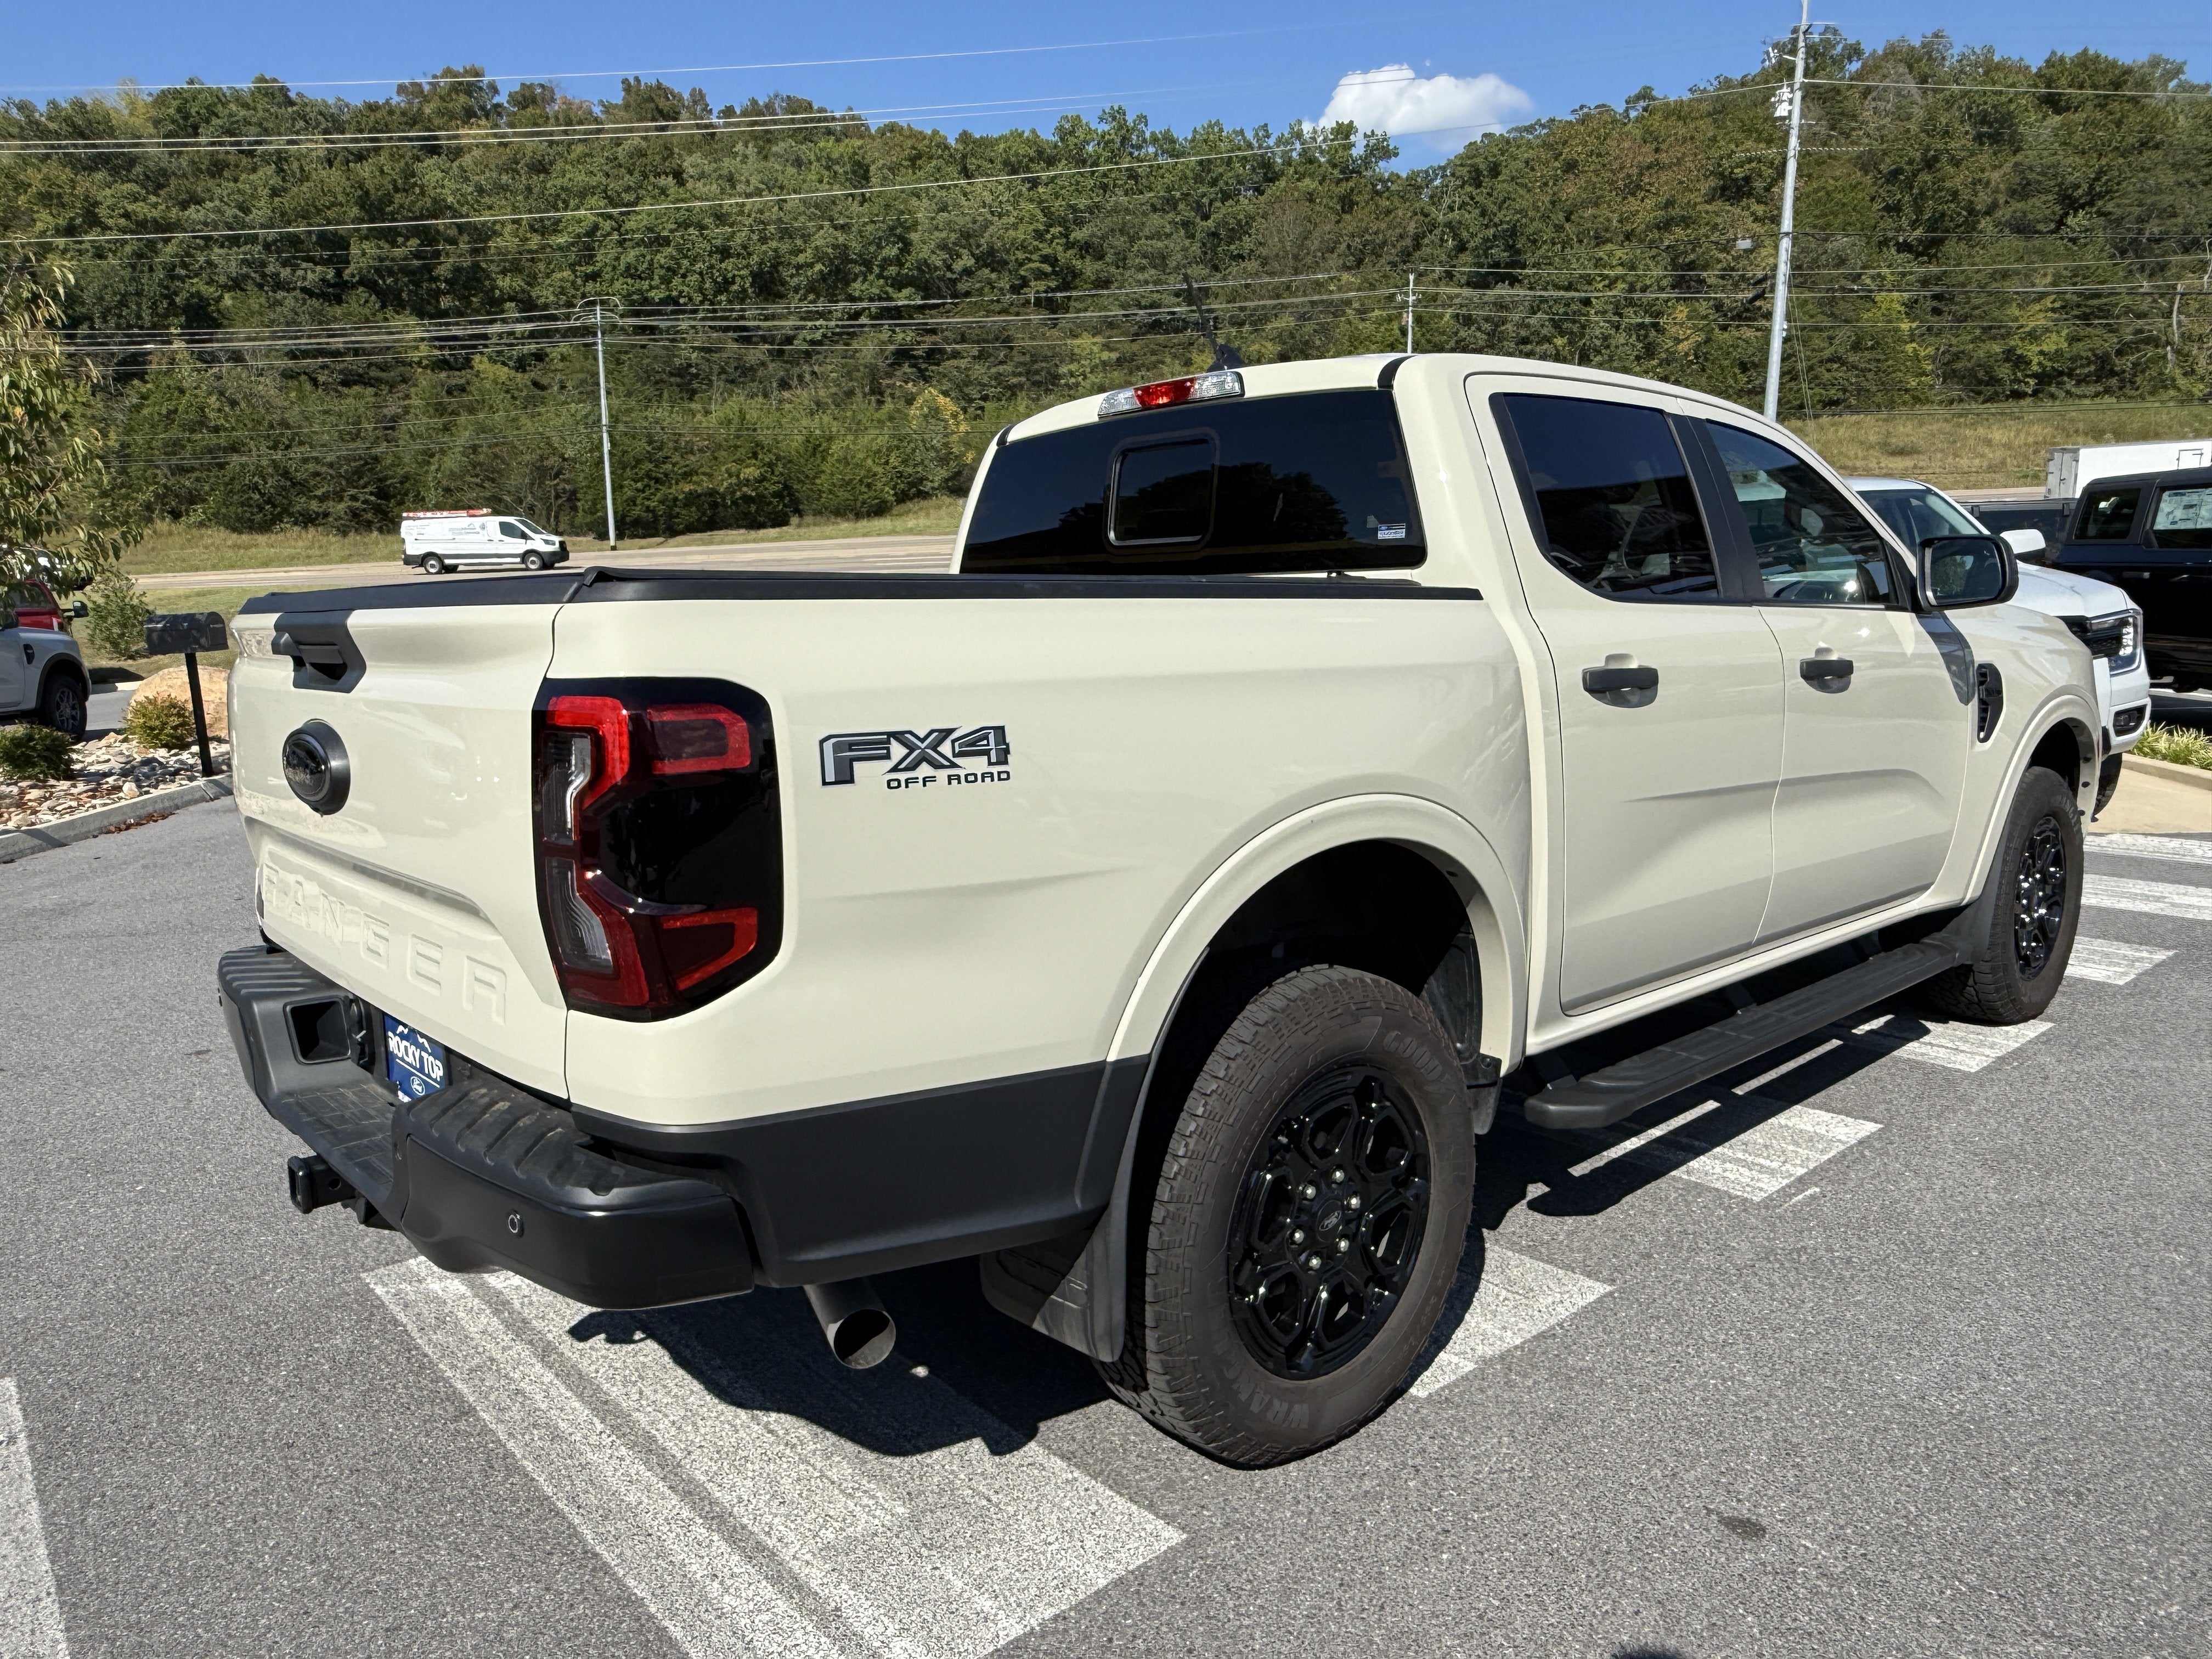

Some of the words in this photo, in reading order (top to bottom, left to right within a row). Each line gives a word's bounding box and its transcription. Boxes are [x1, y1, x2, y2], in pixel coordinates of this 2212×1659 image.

[819, 724, 1011, 787] FX4
[886, 776, 937, 790] OFF
[947, 770, 1011, 786] ROAD
[388, 1031, 420, 1069] ROCKY
[421, 1051, 444, 1081] TOP
